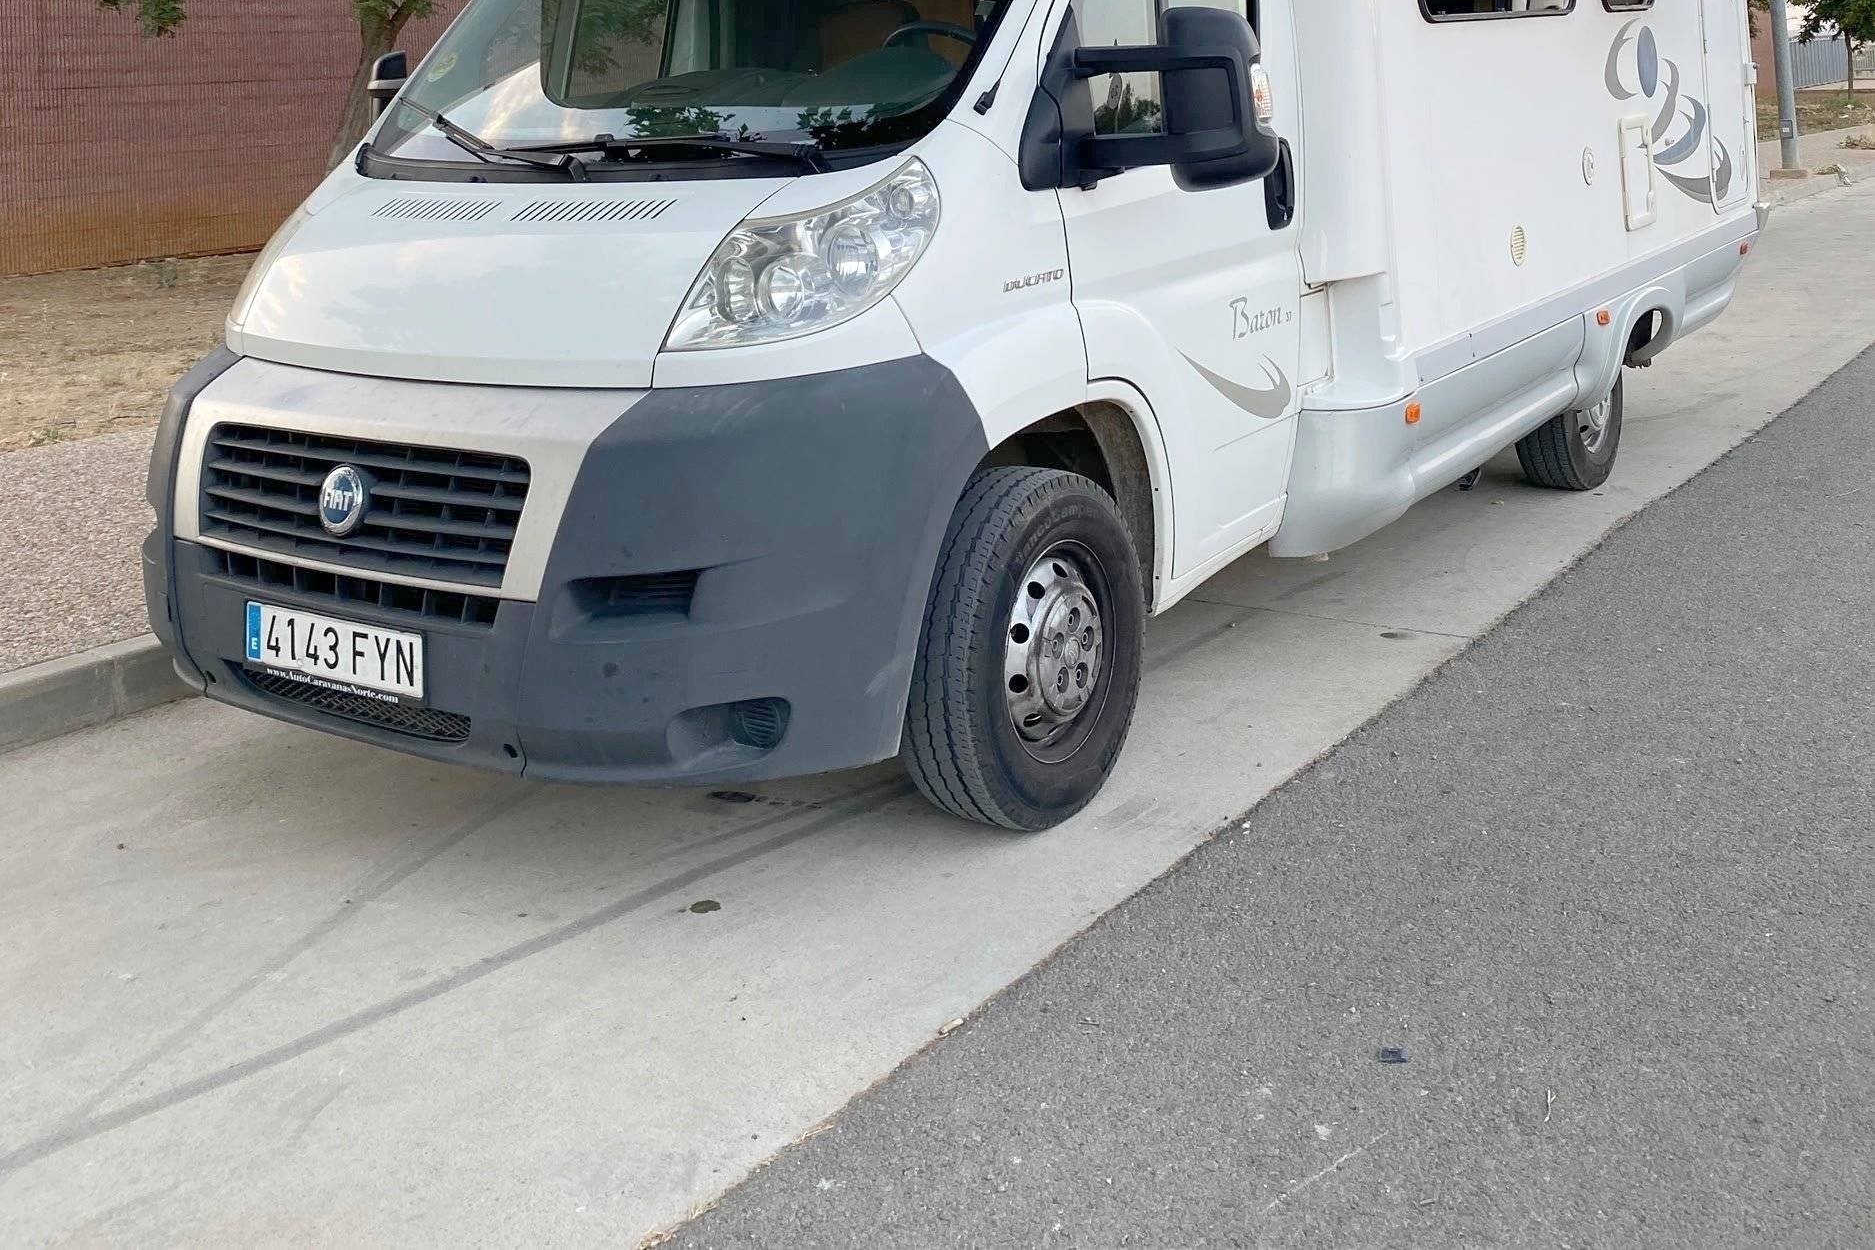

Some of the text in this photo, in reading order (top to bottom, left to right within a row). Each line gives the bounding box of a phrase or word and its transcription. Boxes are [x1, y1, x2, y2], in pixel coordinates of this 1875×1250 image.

[1003, 268, 1064, 293] DUCATO
[323, 487, 353, 511] FIAT
[251, 637, 258, 650] E
[267, 615, 414, 687] 4143 FYN
[266, 667, 399, 704] www.AutoCaravanasNorte.com
